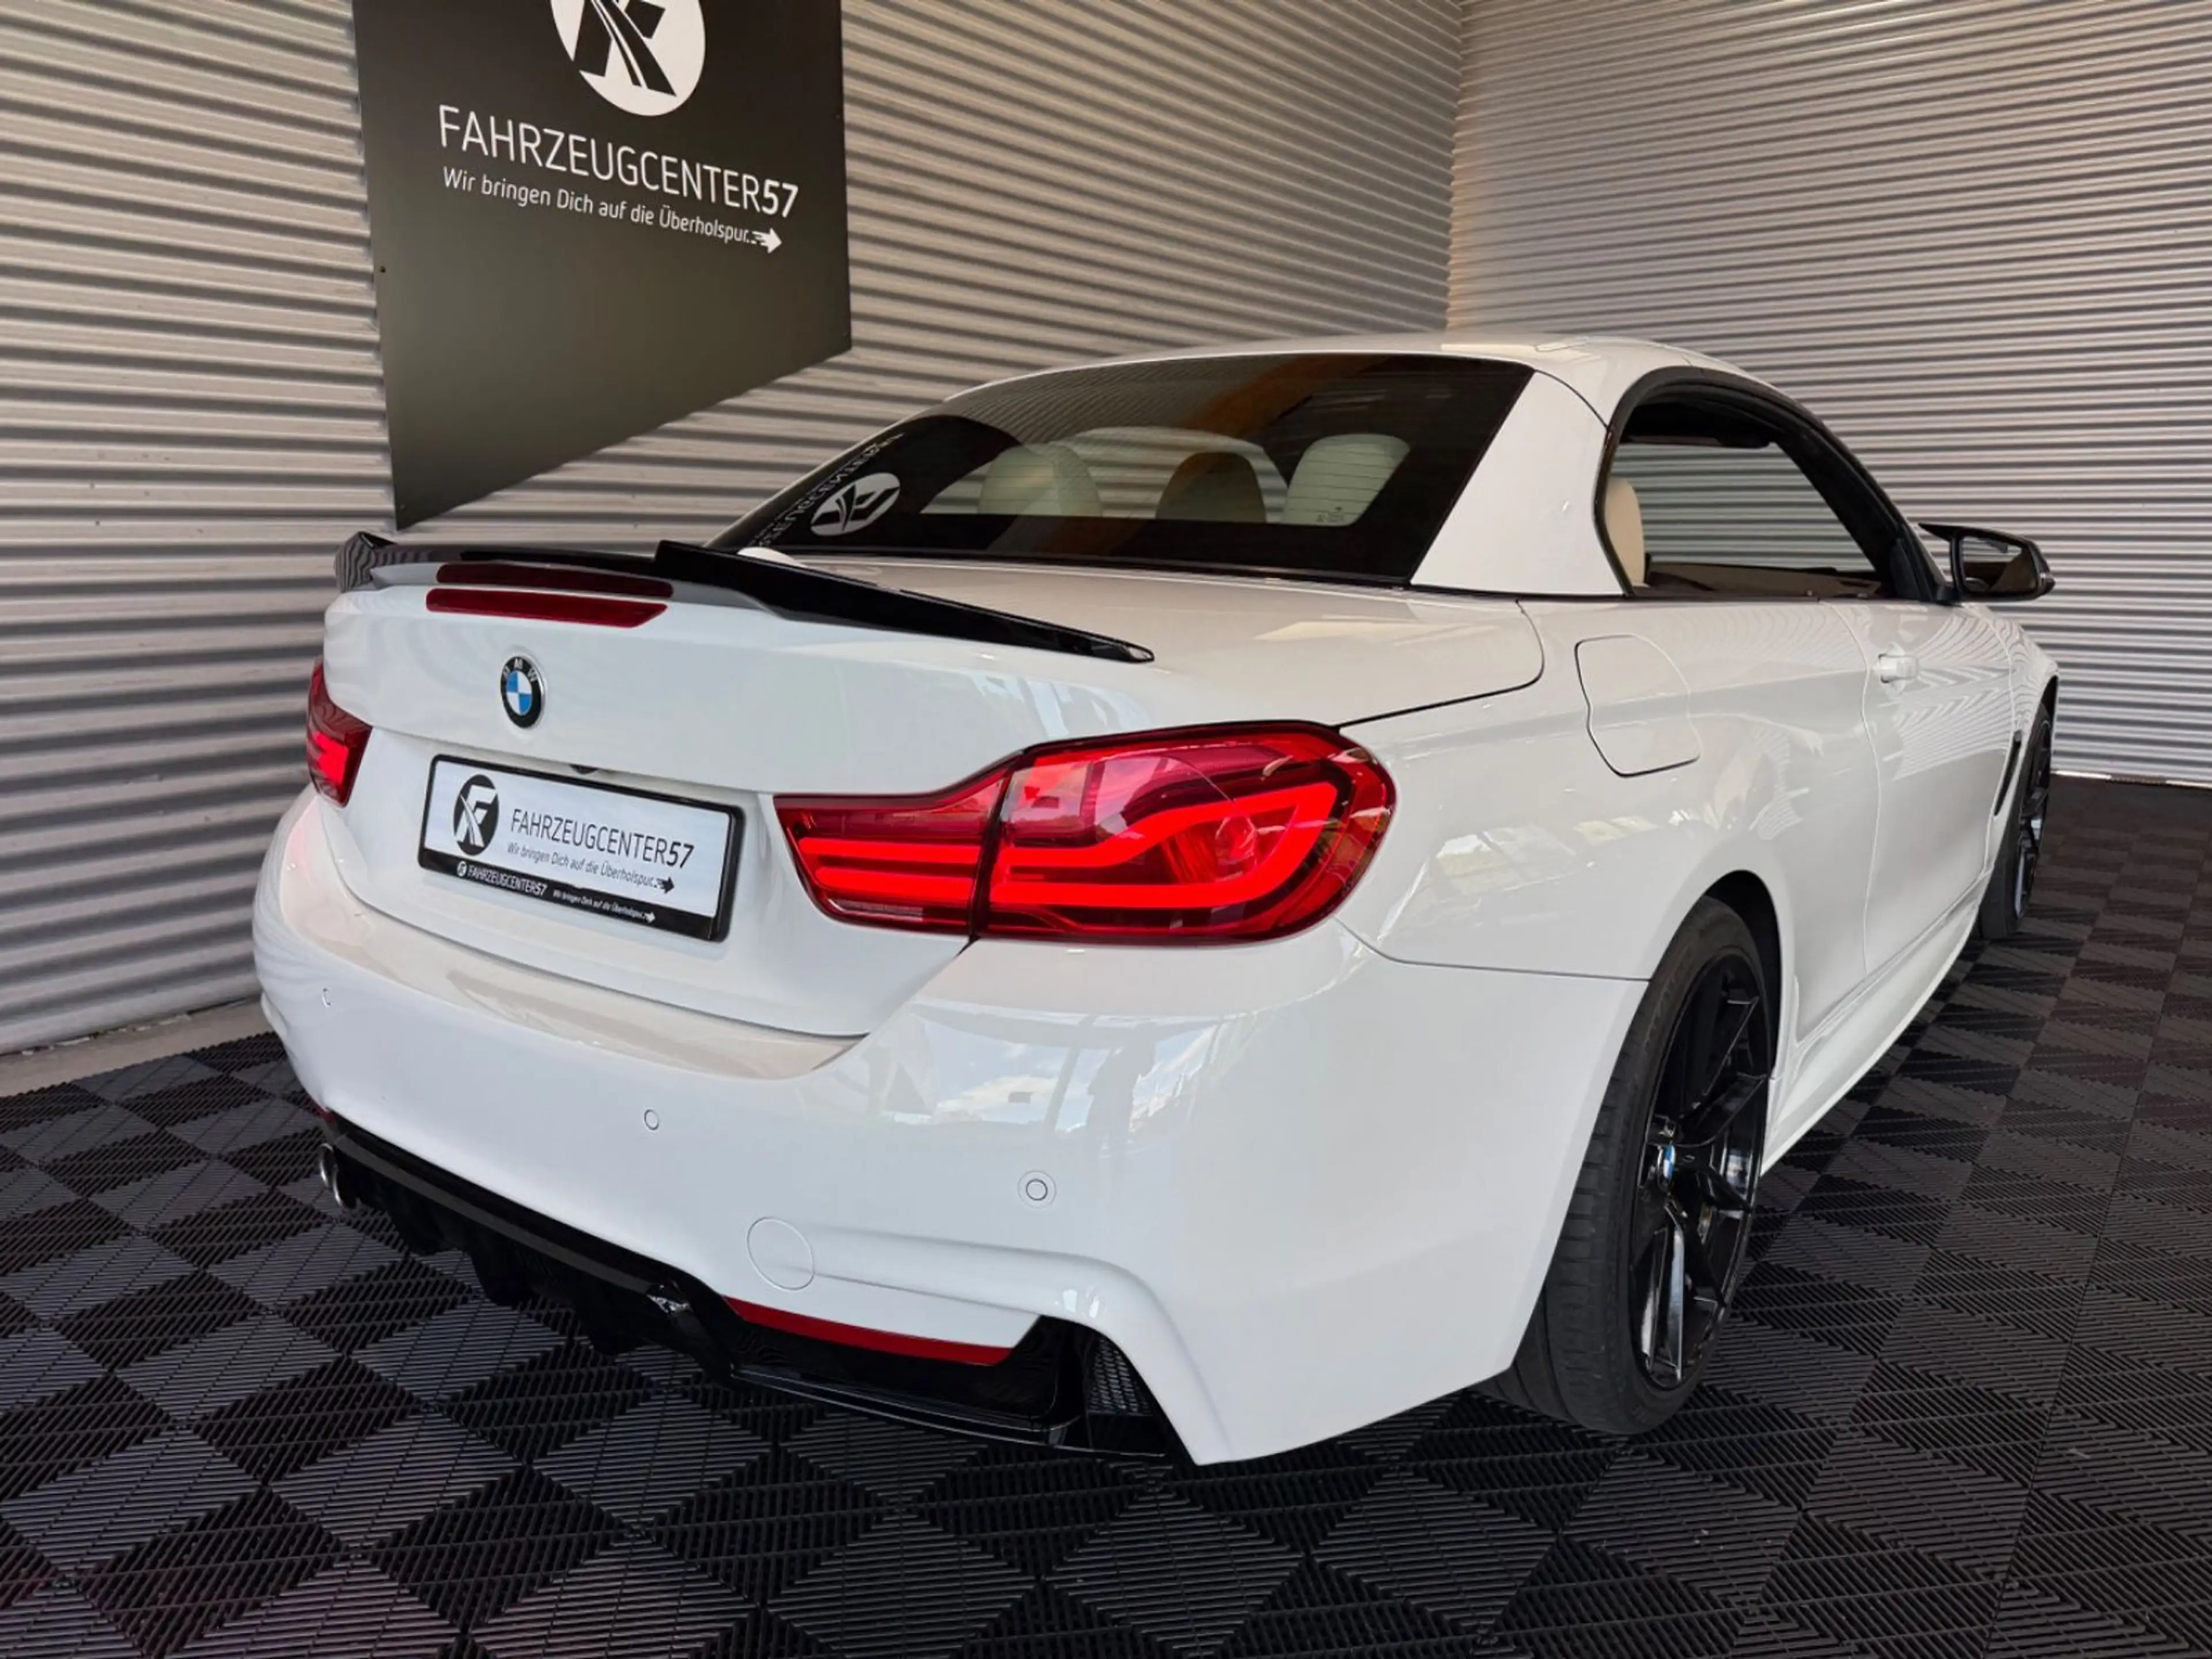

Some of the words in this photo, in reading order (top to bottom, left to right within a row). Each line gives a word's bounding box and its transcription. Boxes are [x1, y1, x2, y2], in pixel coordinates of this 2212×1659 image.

[439, 104, 799, 218] FAHRZEUGCENTER57
[444, 166, 476, 190] Wir
[482, 175, 551, 208] bringen
[557, 188, 593, 214] Dich
[599, 200, 627, 220] auf
[630, 203, 655, 226] die
[510, 808, 695, 869] FAHRZEUGCENTER57
[551, 851, 569, 868] Dich
[468, 865, 548, 896] FAHRZEUGCENTER57
